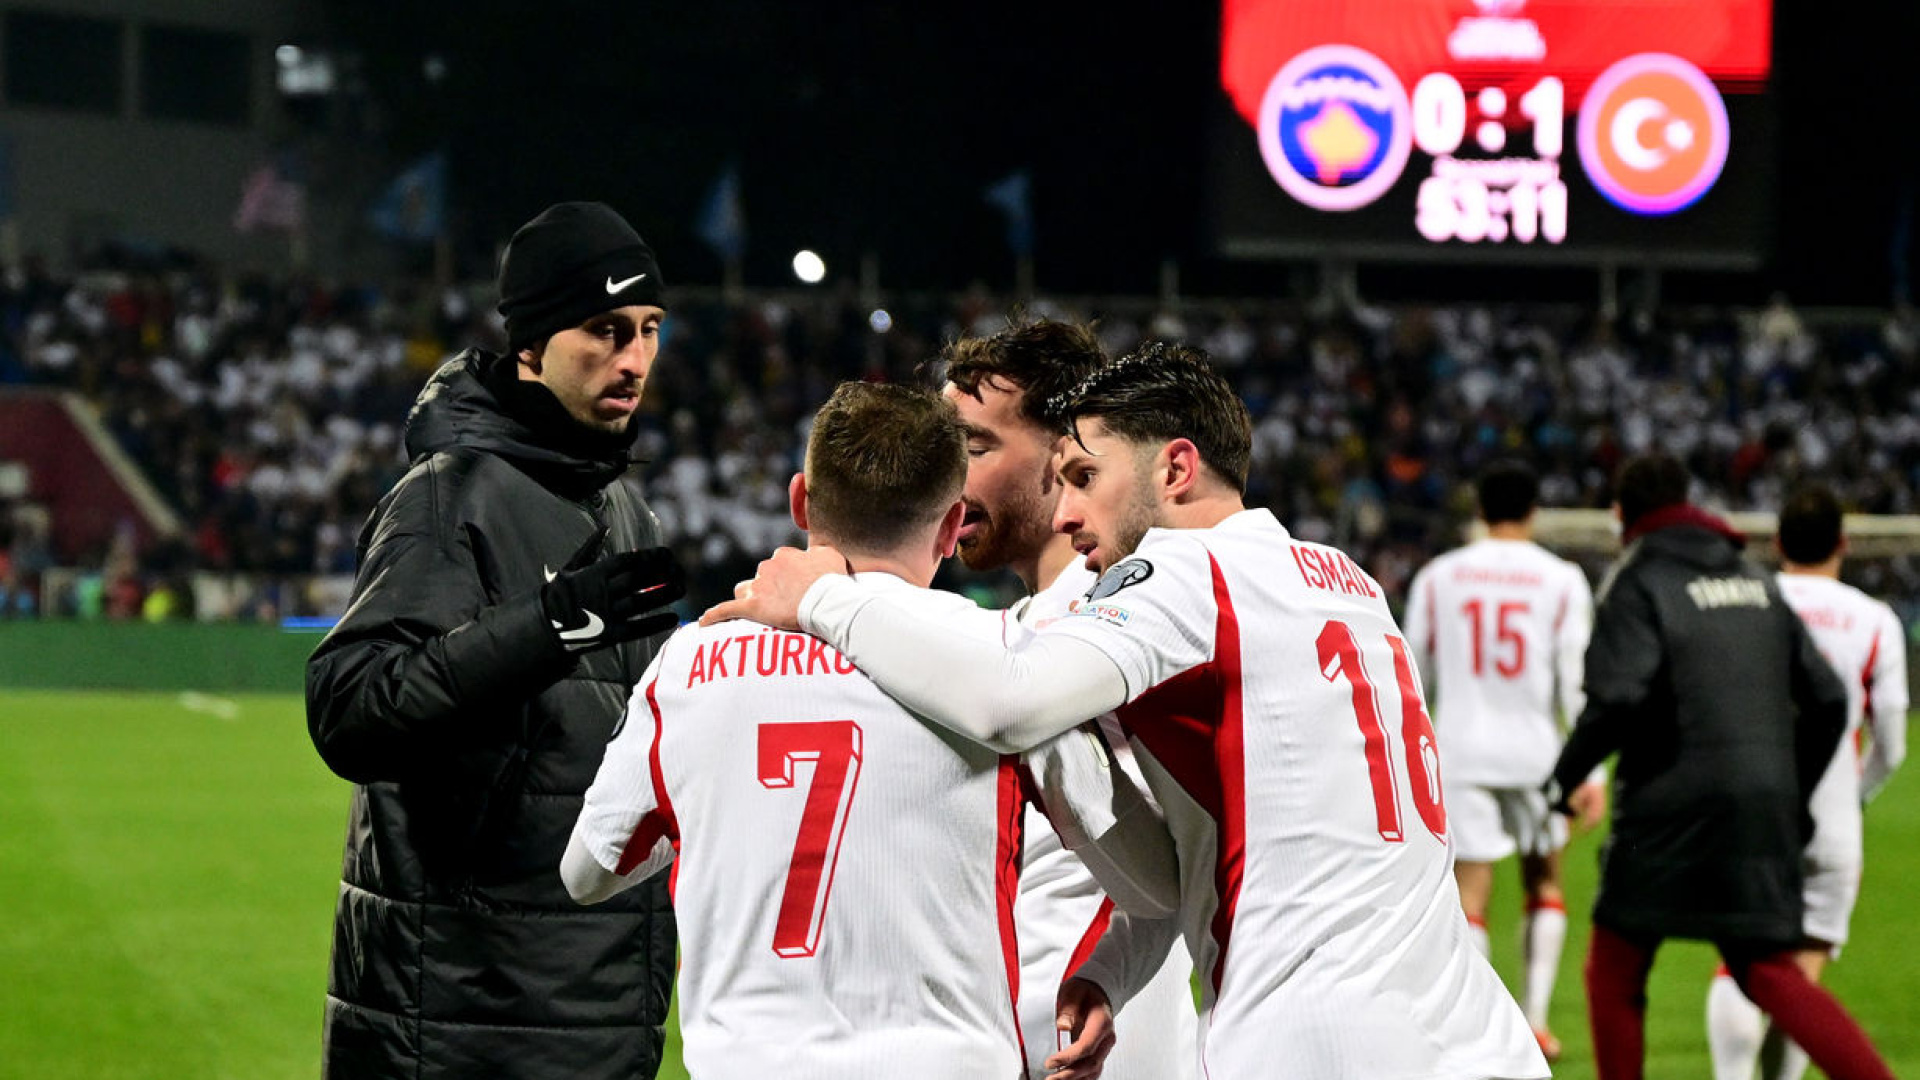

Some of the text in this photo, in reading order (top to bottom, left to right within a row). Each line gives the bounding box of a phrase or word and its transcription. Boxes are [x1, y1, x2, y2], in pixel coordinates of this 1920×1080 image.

[1289, 545, 1377, 599] ISMAIL
[1462, 598, 1530, 681] 15
[1315, 620, 1447, 846] 16
[757, 720, 864, 959] 7
